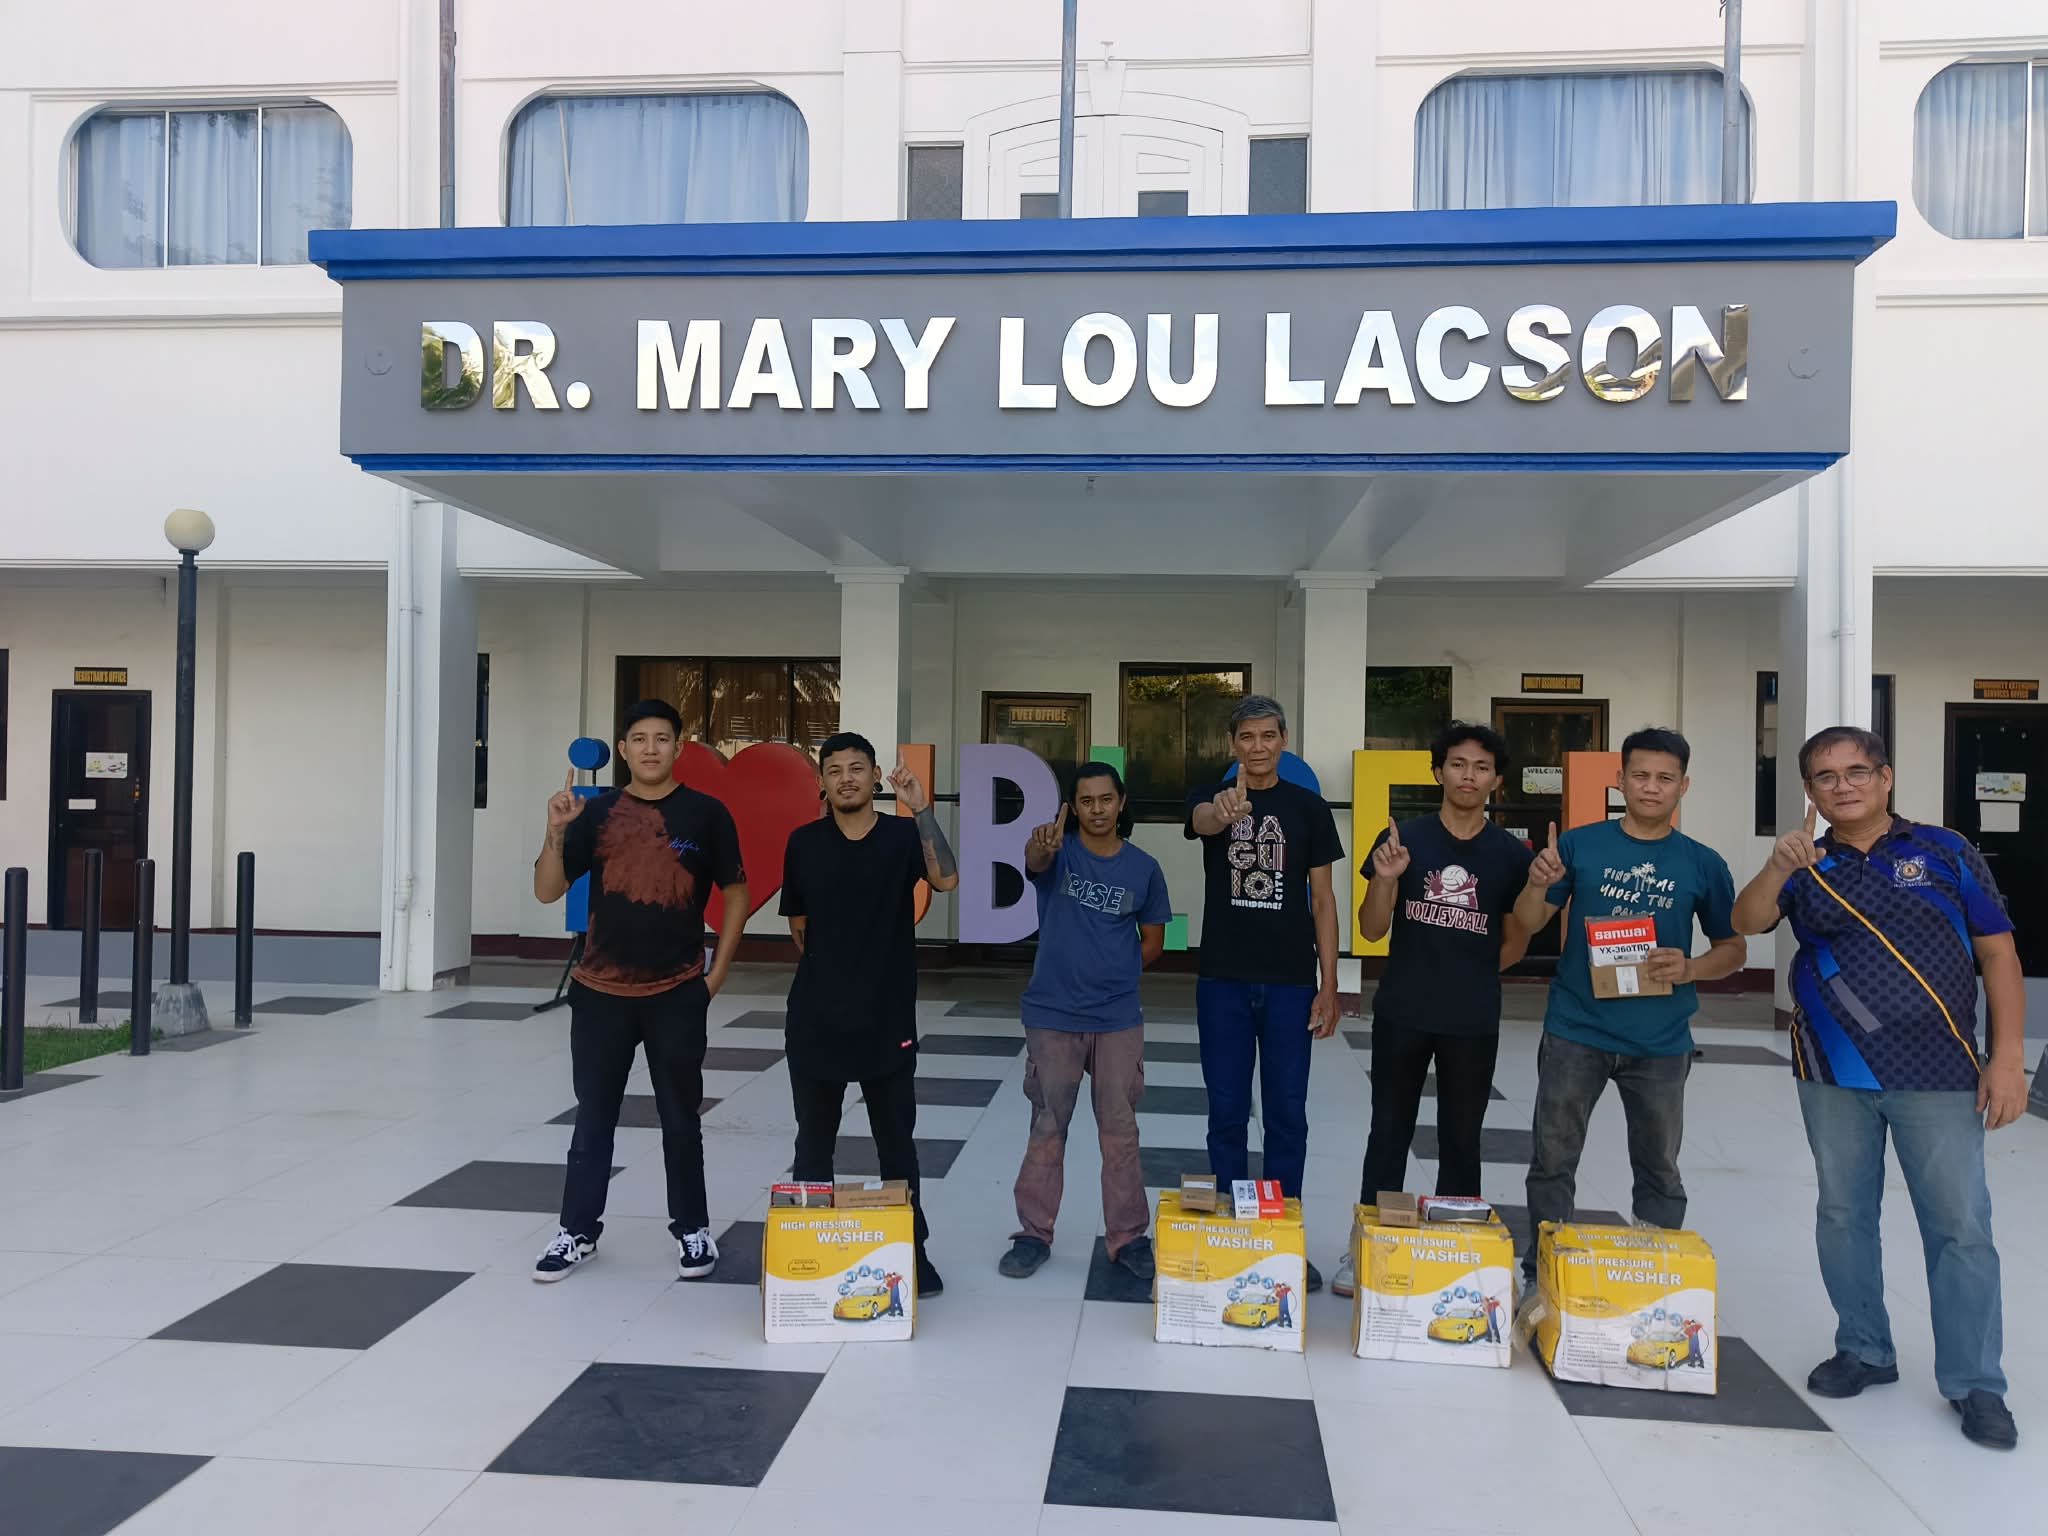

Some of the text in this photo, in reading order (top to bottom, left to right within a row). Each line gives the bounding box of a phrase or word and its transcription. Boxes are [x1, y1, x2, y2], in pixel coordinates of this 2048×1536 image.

[421, 304, 1748, 410] DR. MARY LOU LACSON
[109, 671, 127, 683] OFFICE
[2010, 689, 2028, 698] OFFICE
[1011, 708, 1066, 721] TVET OFFICE
[1274, 871, 1284, 901] CITY
[1603, 867, 1675, 892] FIND ME
[1068, 872, 1126, 912] RISE
[1600, 883, 1675, 909] UNDER THE
[1230, 899, 1283, 910] PHILIPPINES
[1405, 899, 1488, 935] VOLLEYBALL
[780, 1219, 862, 1231] HIGH PRESSURE
[1170, 1222, 1196, 1231] HIGH
[817, 1231, 885, 1244] WASHER
[1206, 1235, 1274, 1251] WASHER
[1373, 1234, 1457, 1248] HIGH PRESSURE
[1410, 1247, 1481, 1264] WASHER
[1567, 1255, 1655, 1269] HIGH PRESSURE
[1606, 1269, 1681, 1286] WASHER
